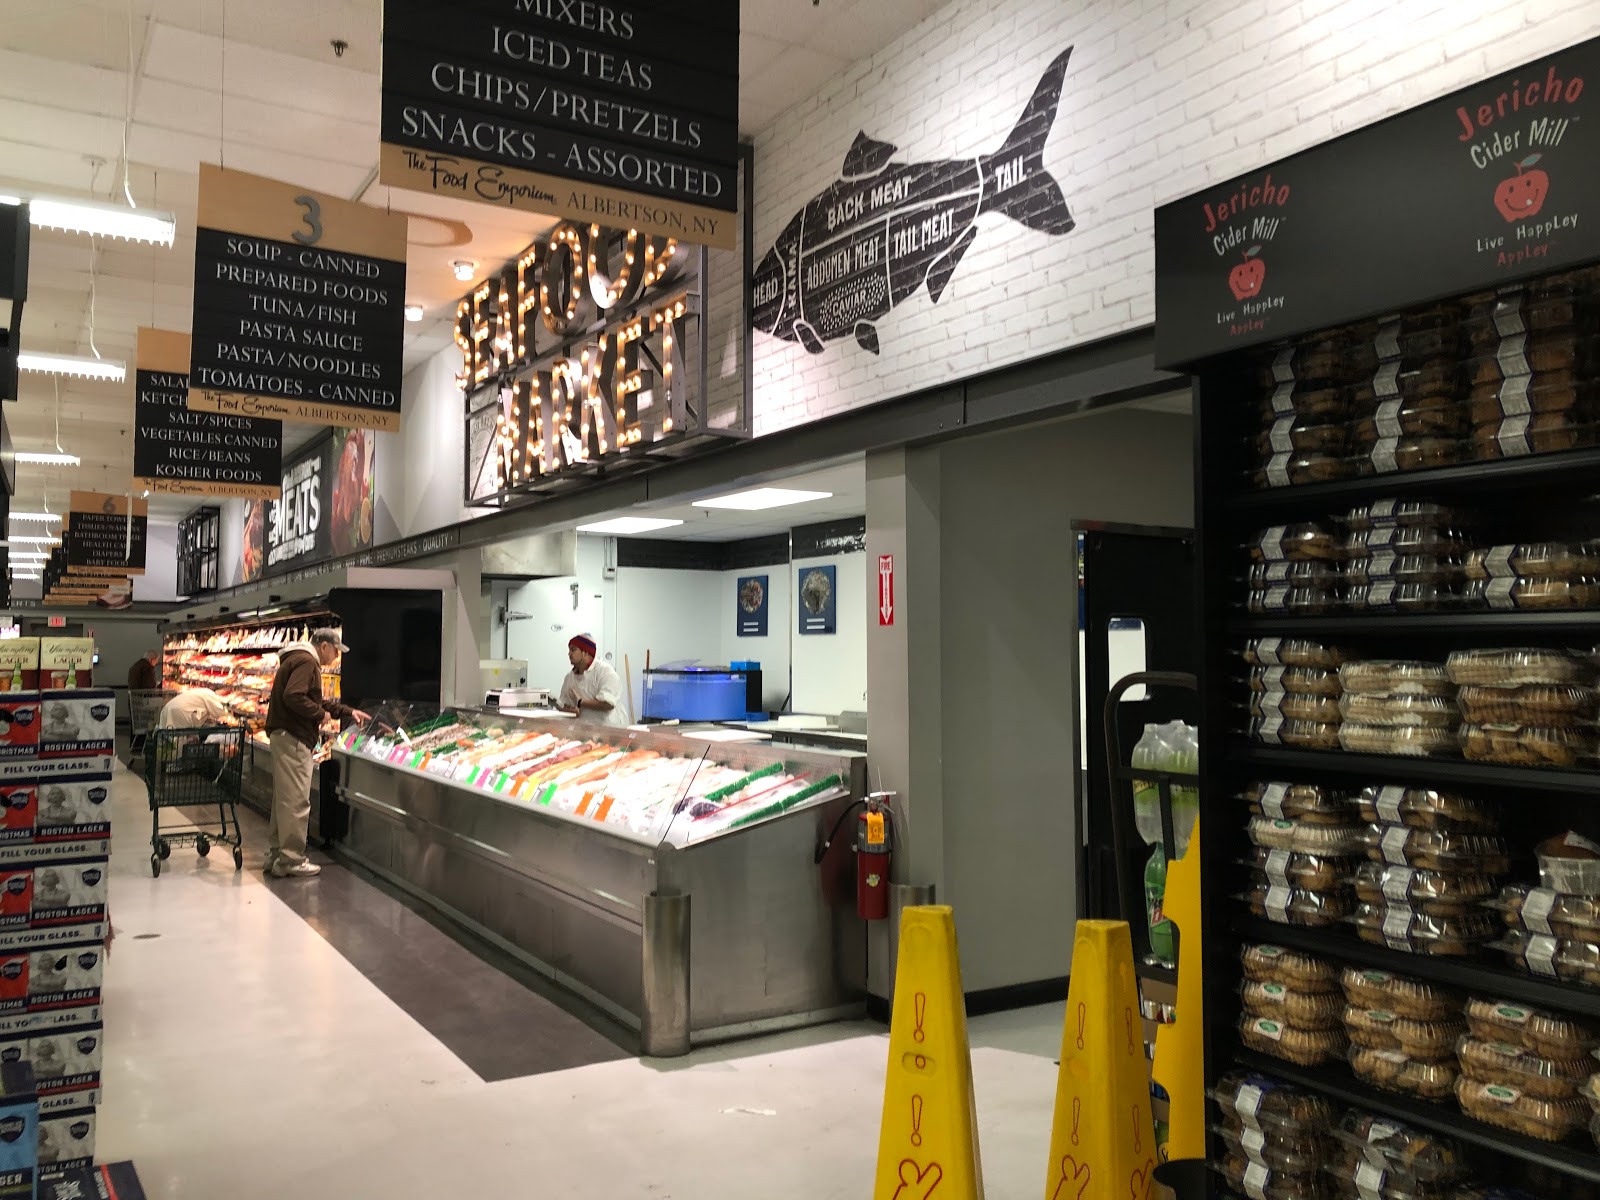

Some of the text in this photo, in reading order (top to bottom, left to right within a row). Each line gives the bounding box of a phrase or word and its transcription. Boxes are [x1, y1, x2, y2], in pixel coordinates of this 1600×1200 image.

[492, 26, 652, 91] ICED TEAS
[431, 62, 701, 149] CHIPS/PRETZELS
[1456, 66, 1585, 142] Jericho
[402, 106, 536, 161] SNACKS
[564, 143, 722, 198] ASSORTED
[1470, 116, 1569, 169] Cider Mill
[995, 155, 1027, 192] TAIL
[402, 150, 718, 236] The Food Emporium ALBERTSON, NY
[827, 175, 912, 230] BACK MEAT
[1203, 174, 1290, 232] Jericho
[291, 196, 323, 245] 3
[894, 209, 955, 259] TAIL MEAT
[1213, 215, 1279, 256] Cider Mill
[227, 238, 281, 261] SOUP
[300, 252, 380, 279] CANNED
[1477, 236, 1504, 252] Live
[807, 236, 880, 291] ABDOMEN MEAT
[216, 263, 388, 305] PREPARED FOODS
[753, 277, 778, 309] HEAD
[249, 294, 356, 326] TUNA/FISH
[832, 289, 867, 316] CAVIAR
[1217, 311, 1235, 324] Live
[239, 320, 362, 352] PASTA SAUCE
[217, 343, 380, 380] PASTA/NOODLES
[198, 367, 303, 395] TOMATOES
[319, 383, 395, 407] CANNED
[497, 292, 687, 490] MARKET
[169, 412, 252, 430] SALT/SPICES
[201, 391, 388, 427] The Food Emporium ALBERTSON, NY
[141, 427, 278, 449] VEGETABLES CANNED
[156, 464, 262, 482] KOSHER FOODS
[169, 448, 251, 464] RICE/BEANS
[261, 489, 273, 497] NY
[274, 474, 321, 547] MEATS
[423, 533, 449, 552] QUALITY
[44, 741, 107, 751] BOSTON LAGER
[4, 766, 24, 774] FILL
[27, 764, 55, 773] YOUR
[41, 825, 104, 836] BOSTON LAGER
[1, 849, 20, 858] FILL
[24, 847, 52, 857] YOUR
[34, 907, 98, 919] BOSTON LAGER
[17, 933, 45, 943] YOUR
[31, 990, 94, 1004] BOSTON LAGER
[37, 1075, 93, 1089] OSTON LAGER
